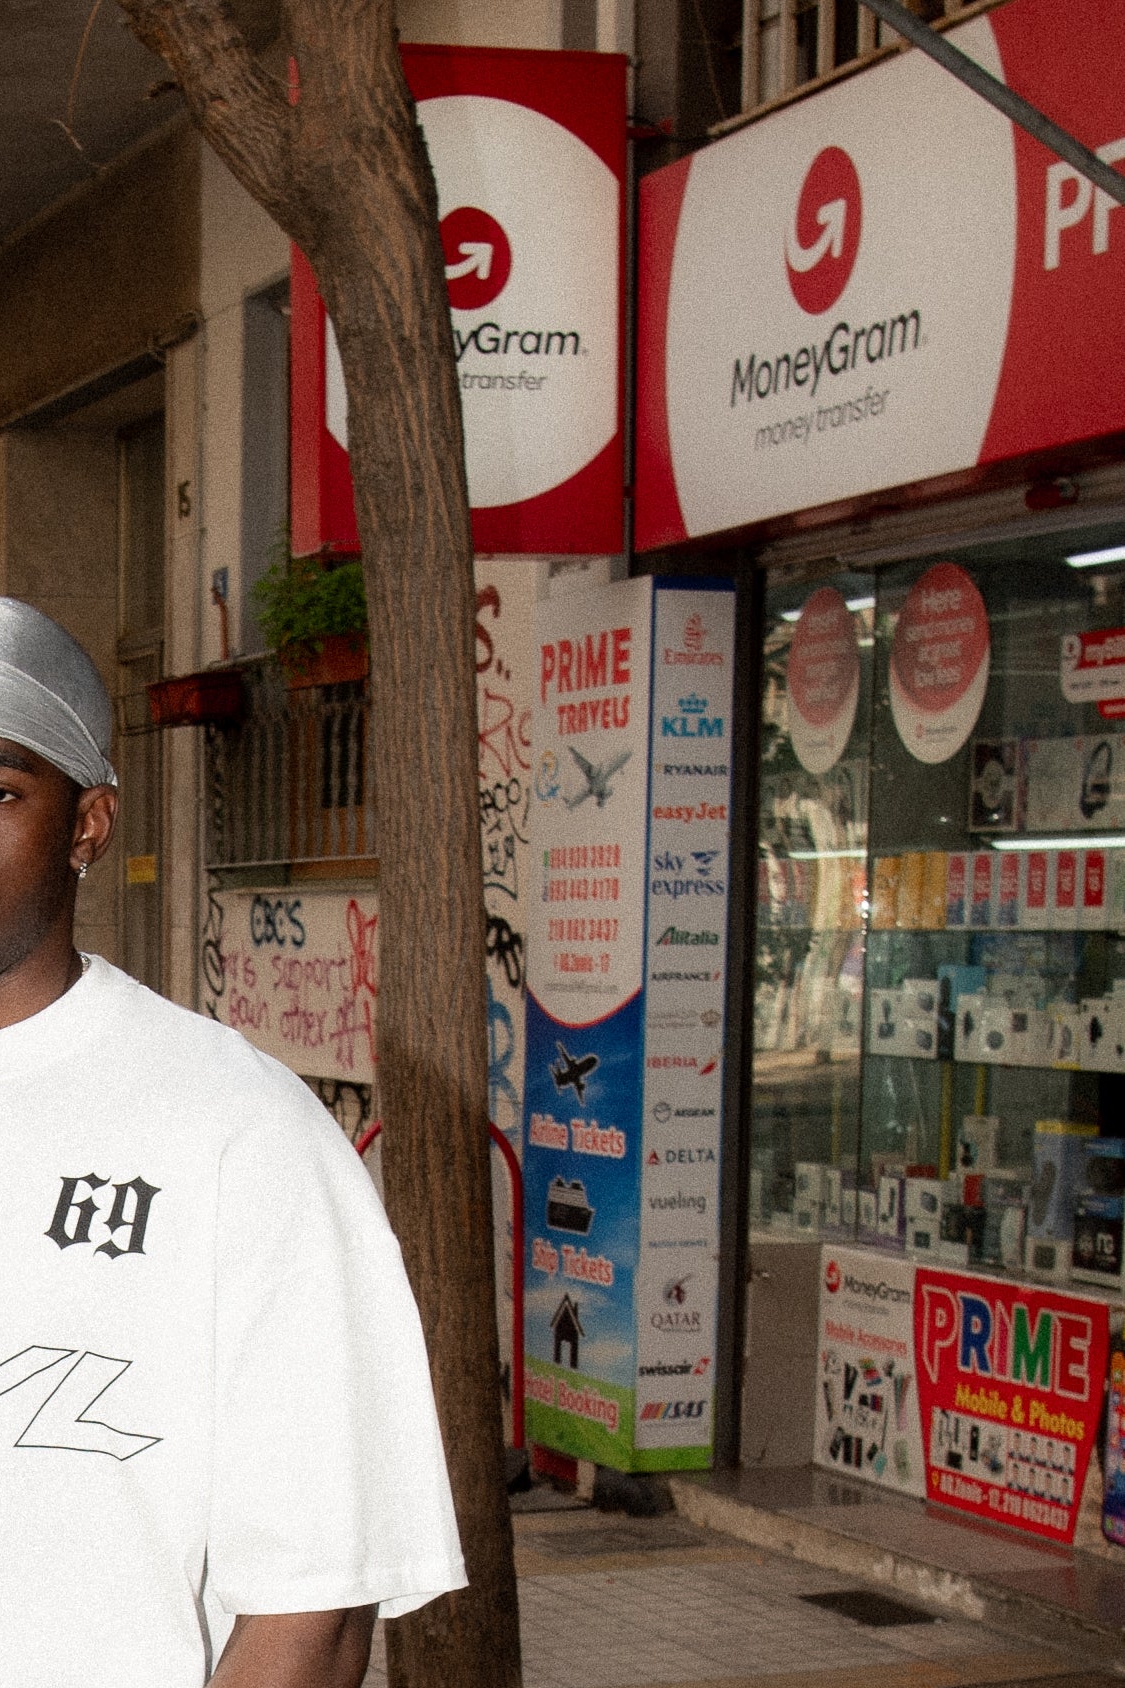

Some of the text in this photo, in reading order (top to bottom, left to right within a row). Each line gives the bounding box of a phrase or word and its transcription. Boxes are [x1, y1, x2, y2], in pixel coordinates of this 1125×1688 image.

[454, 322, 580, 362] yGram
[730, 309, 921, 407] MoneyGram
[462, 370, 548, 400] transfer
[754, 387, 890, 450] money transfer
[541, 627, 631, 705] PRIME
[558, 696, 630, 735] TRAVELS
[661, 717, 723, 738] KLM
[663, 764, 727, 775] RYANAIR
[653, 802, 727, 824] easyJet
[654, 850, 684, 875] sky
[652, 879, 724, 900] express
[655, 926, 719, 945] Alitalia
[651, 972, 710, 982] AIRFRANCE
[647, 1057, 698, 1068] IBERIA
[675, 1109, 716, 1117] AEGEAN
[529, 1114, 625, 1158] Airline Tickets
[666, 1150, 716, 1163] DELTA
[649, 1191, 707, 1213] vueling
[43, 1171, 162, 1260] 69
[533, 1239, 613, 1286] Ship Tickets
[844, 1275, 910, 1304] MoneyGram
[651, 1312, 701, 1329] QATAR
[921, 1284, 1092, 1403] PRIME
[639, 1361, 692, 1376] swissair
[558, 1379, 619, 1434] Booking
[668, 1400, 707, 1418] SAS
[955, 1383, 1085, 1440] Mobile & Photos
